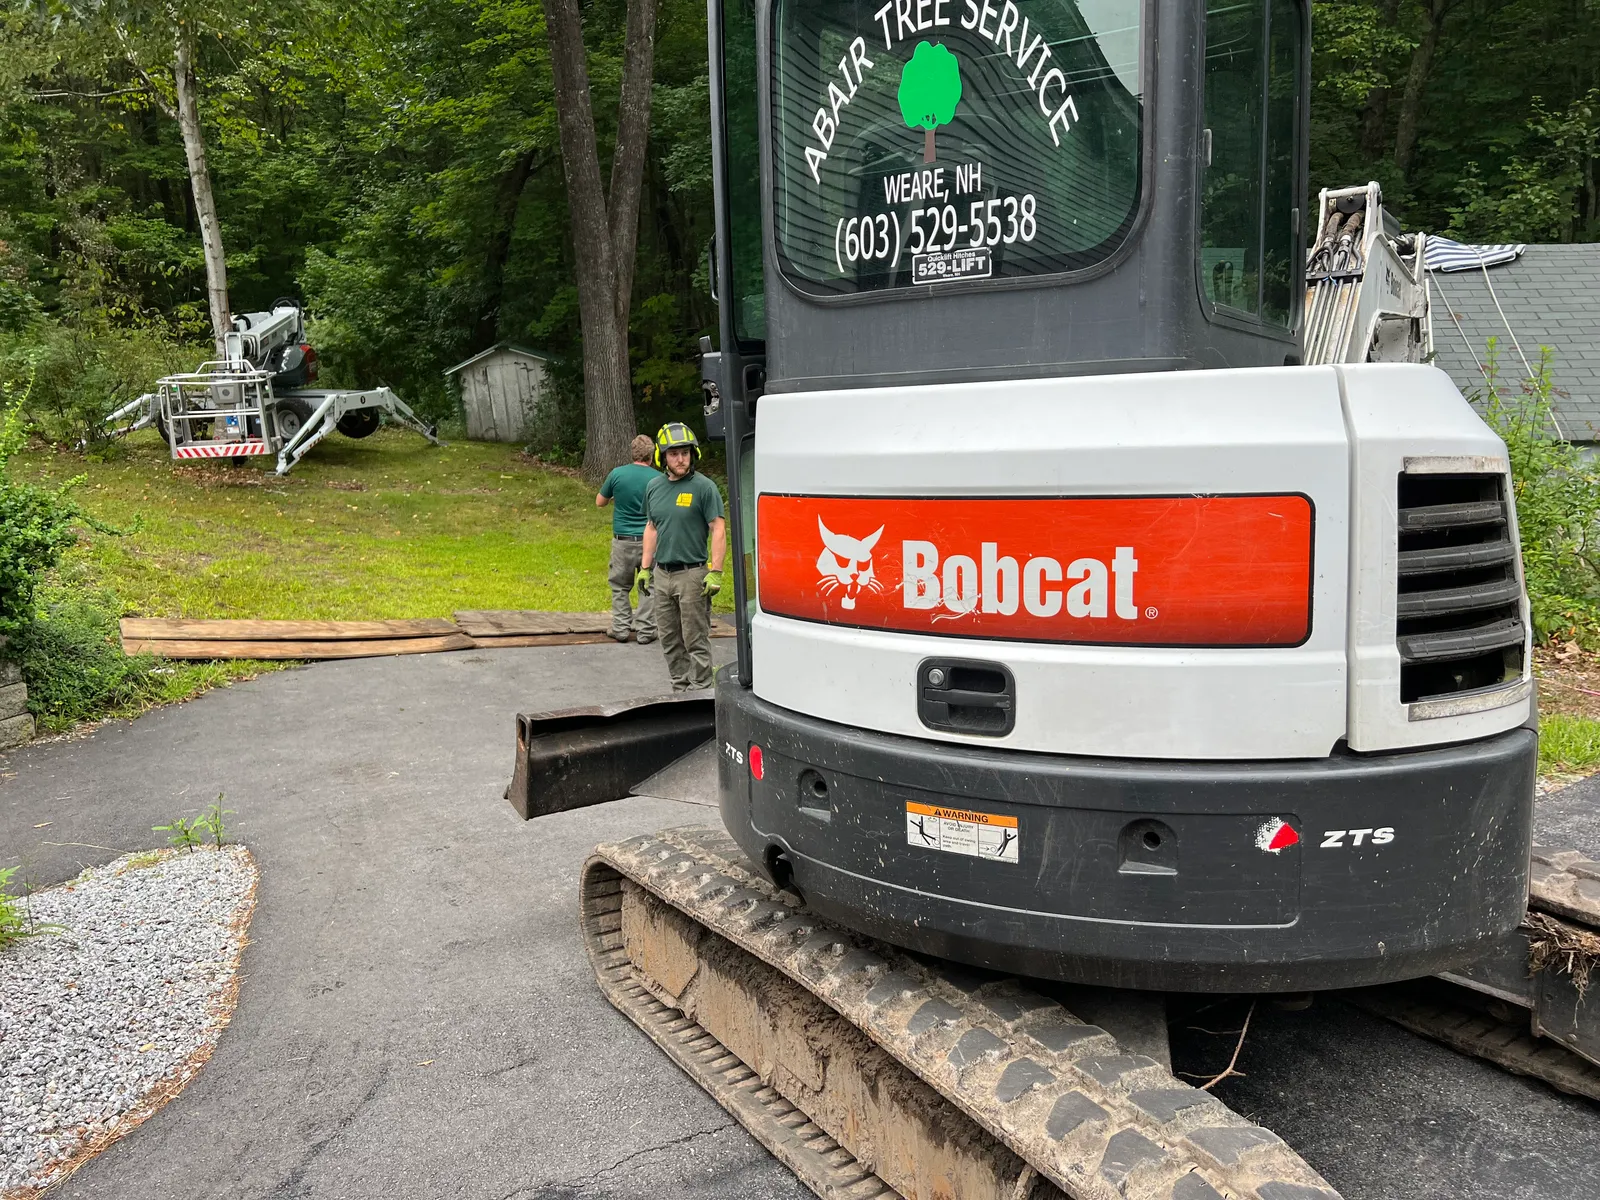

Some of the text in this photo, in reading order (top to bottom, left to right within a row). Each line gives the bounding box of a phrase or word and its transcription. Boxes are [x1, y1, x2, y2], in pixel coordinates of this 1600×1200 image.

[804, 0, 1079, 185] ABAIR TREE SERVICE
[883, 162, 982, 204] WEARE, NH
[835, 194, 1037, 273] (603) 529-5538
[918, 256, 986, 276] 529-LIFT
[927, 251, 976, 262] Quicklift Hitches
[902, 540, 1139, 620] Bobcat
[725, 741, 744, 765] ZTS
[942, 810, 988, 822] WARNING
[1319, 826, 1395, 848] ZTS
